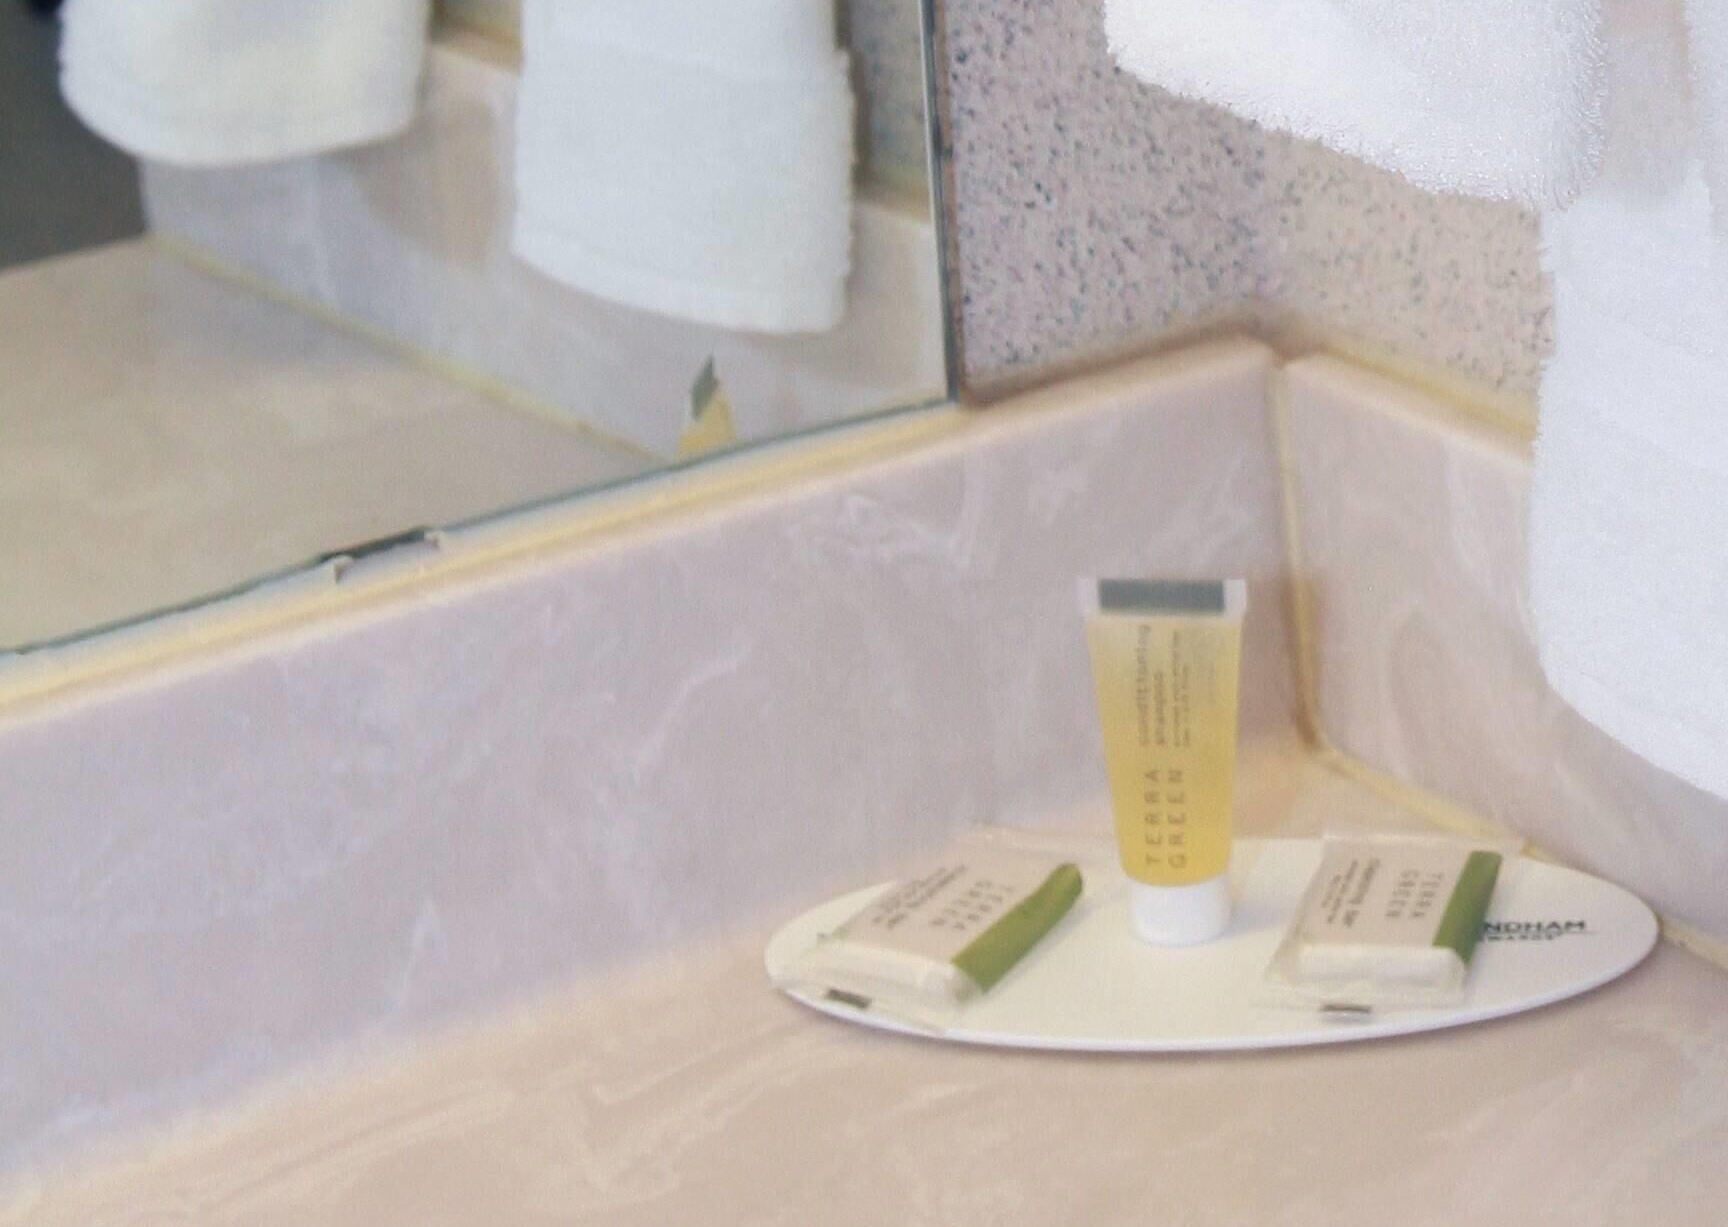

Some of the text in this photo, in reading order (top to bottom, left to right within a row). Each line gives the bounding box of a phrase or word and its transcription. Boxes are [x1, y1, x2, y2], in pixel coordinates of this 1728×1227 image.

[1144, 768, 1163, 866] TERRA
[1166, 768, 1188, 869] GREEN
[1483, 920, 1586, 934] NDHAM
